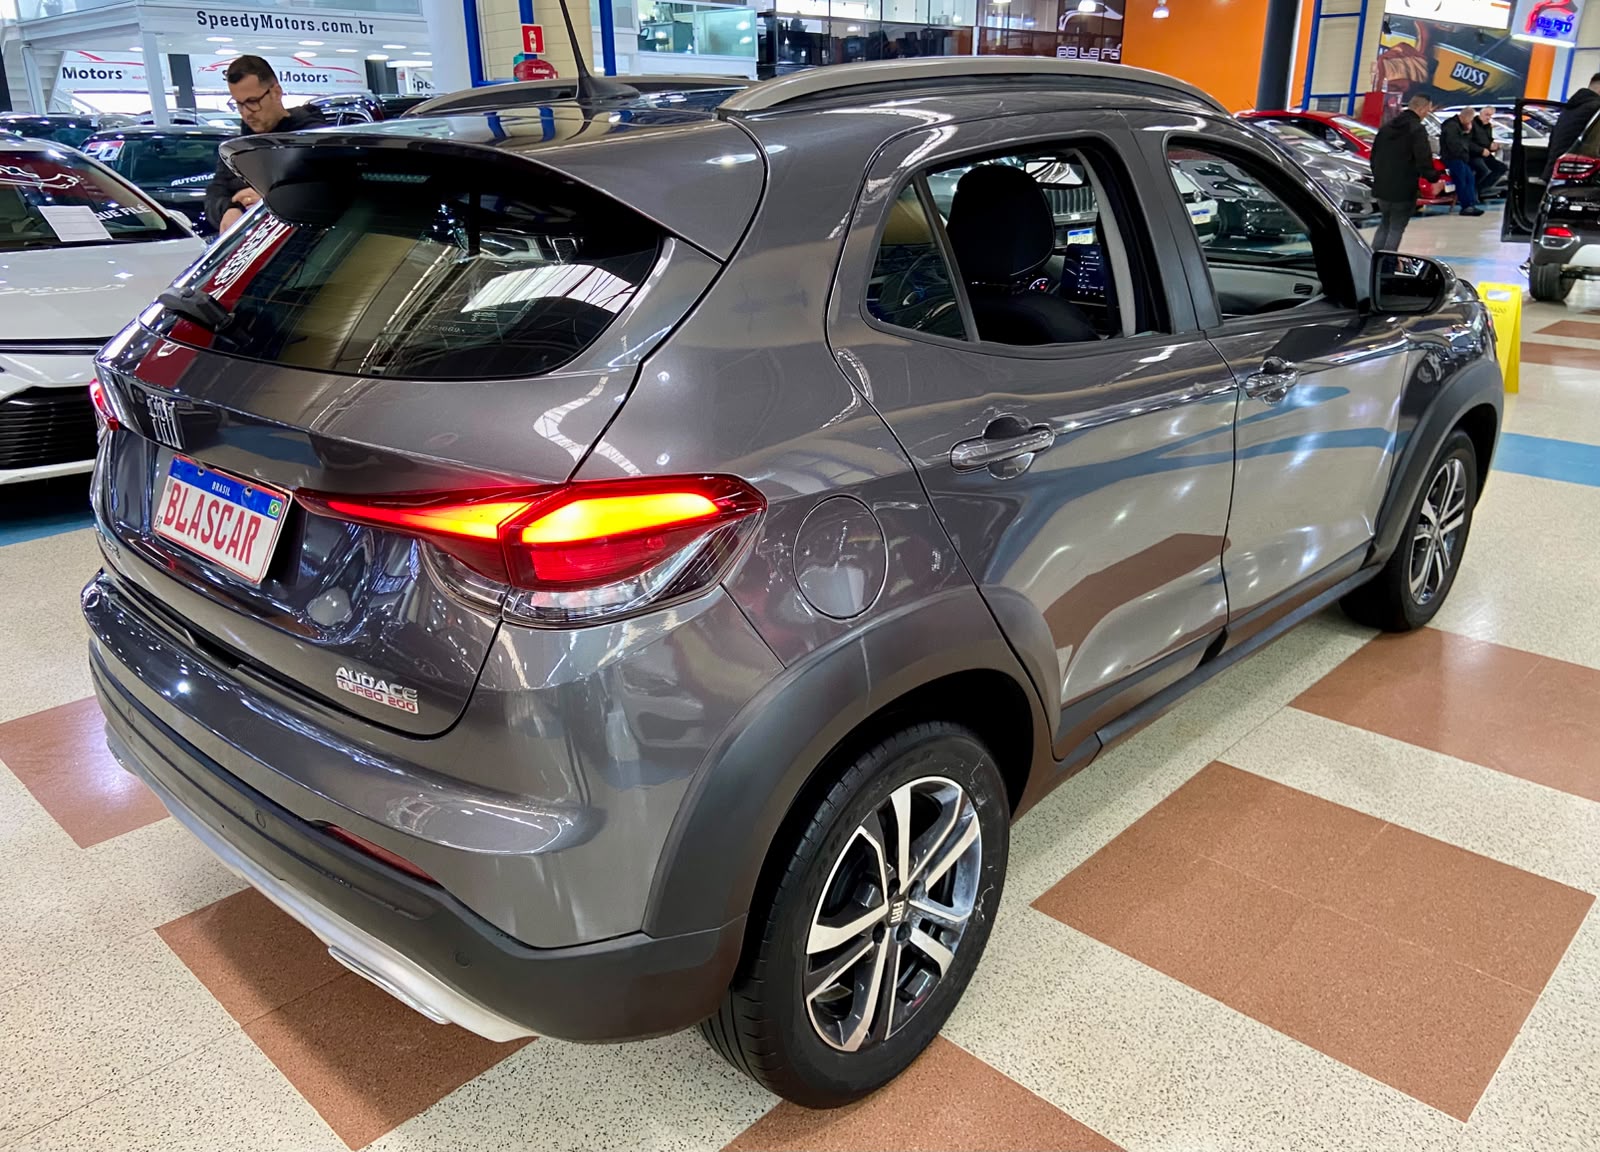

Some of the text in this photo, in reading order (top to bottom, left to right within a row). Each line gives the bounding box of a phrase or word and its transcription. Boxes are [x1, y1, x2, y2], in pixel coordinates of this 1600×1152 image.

[197, 10, 375, 35] SpeedyMotors.com.br
[62, 66, 123, 80] Motors
[1452, 62, 1487, 87] BOSS
[211, 480, 232, 497] BRASIL
[162, 481, 263, 566] BLASCAR
[335, 666, 418, 702] AUDACE
[337, 679, 417, 713] TURBO 200
